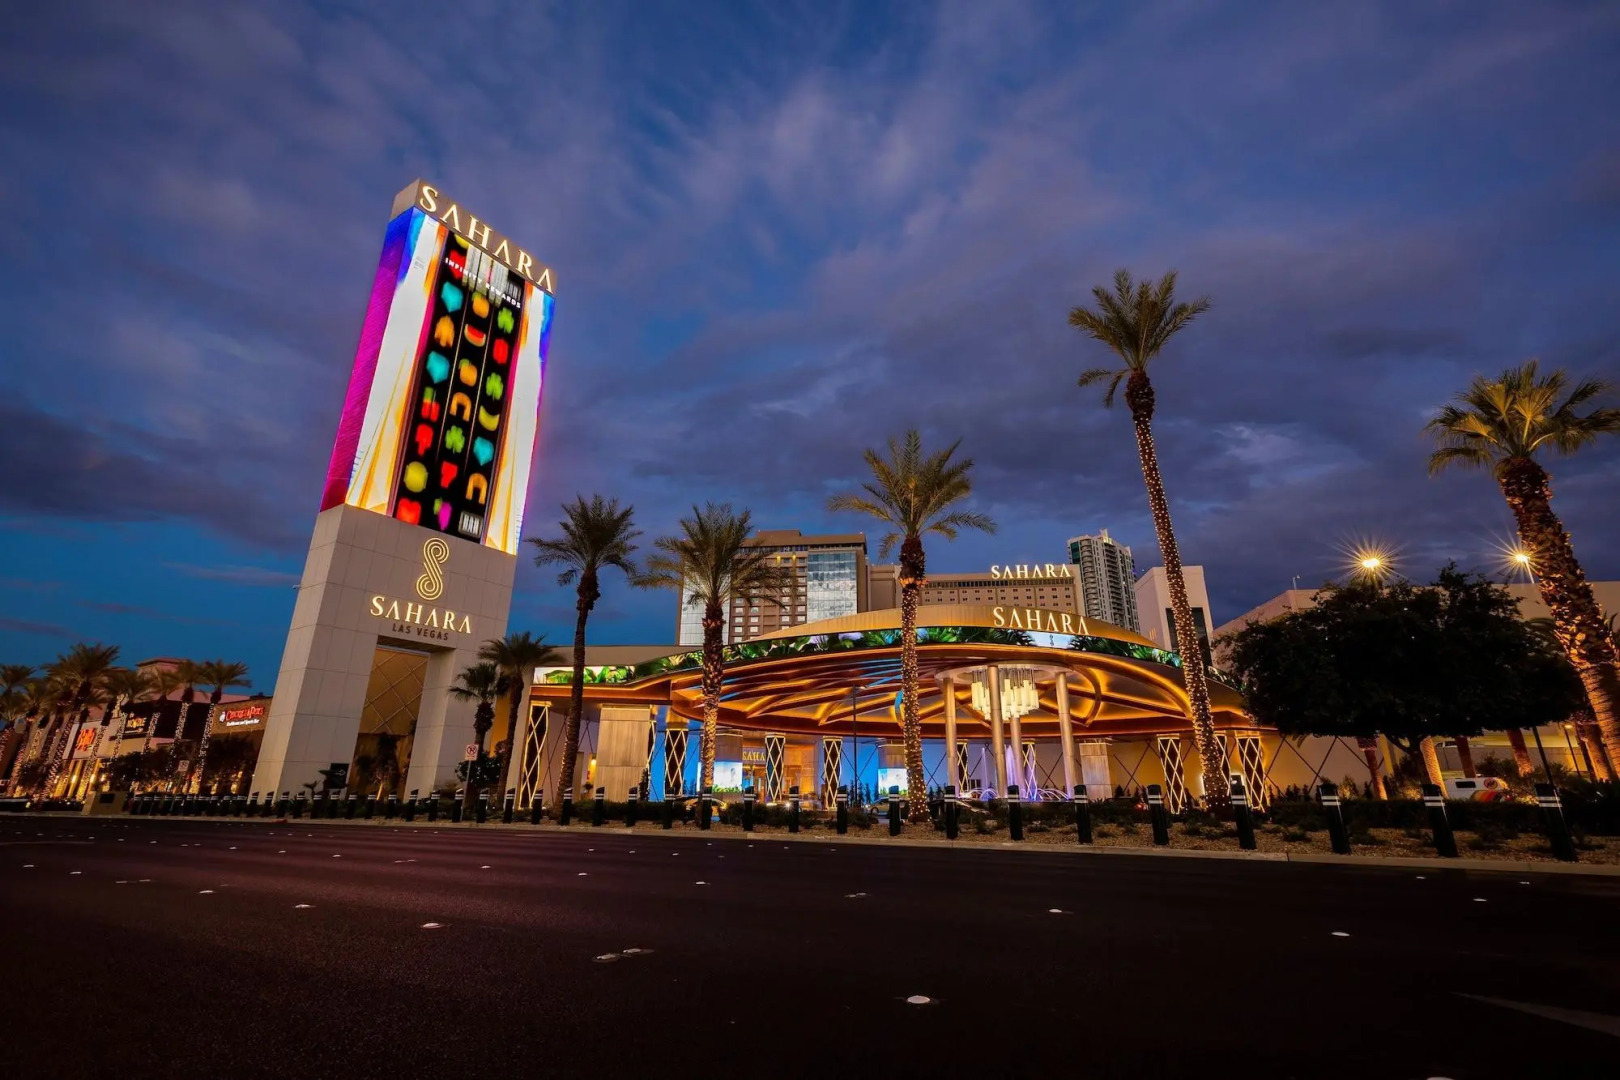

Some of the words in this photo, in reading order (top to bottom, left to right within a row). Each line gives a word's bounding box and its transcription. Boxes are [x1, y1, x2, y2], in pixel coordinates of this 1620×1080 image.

[420, 186, 554, 294] SAHARA
[445, 257, 482, 284] INFINITY
[485, 283, 521, 309] REWARDS
[991, 564, 1071, 579] SAHARA
[370, 597, 471, 634] SAHARA
[993, 607, 1089, 635] SAHARA
[392, 623, 411, 634] LAS
[416, 628, 448, 641] VEGAS
